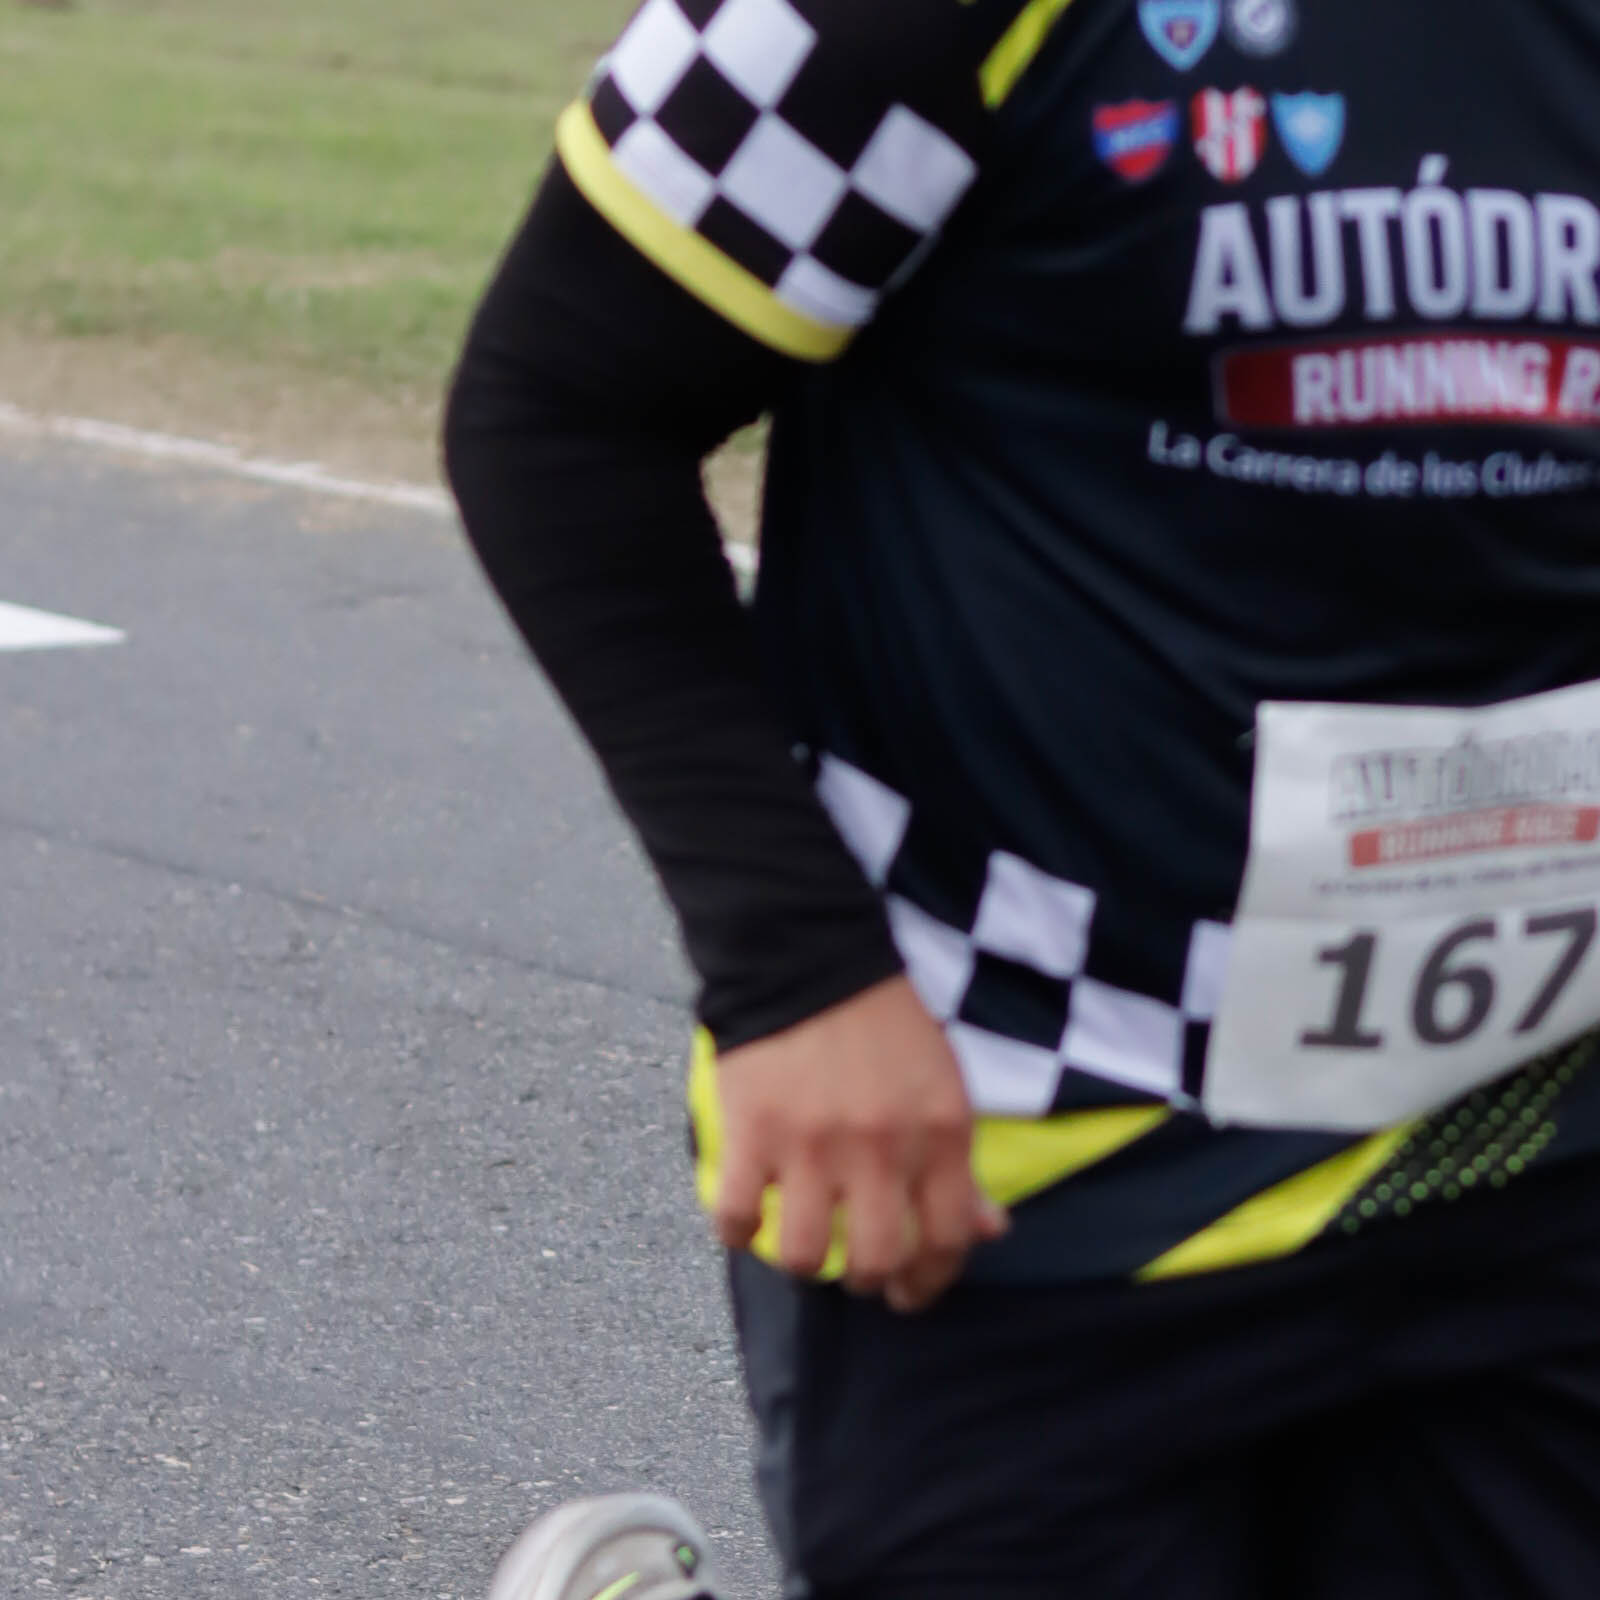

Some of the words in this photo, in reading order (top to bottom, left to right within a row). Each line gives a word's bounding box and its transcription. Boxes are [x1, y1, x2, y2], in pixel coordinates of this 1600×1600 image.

[1291, 338, 1551, 428] RUNNING
[1148, 419, 1201, 469] La
[1206, 432, 1360, 496] Carrera
[1364, 449, 1418, 496] de
[1422, 449, 1478, 496] los
[1297, 906, 1600, 1052] 167
